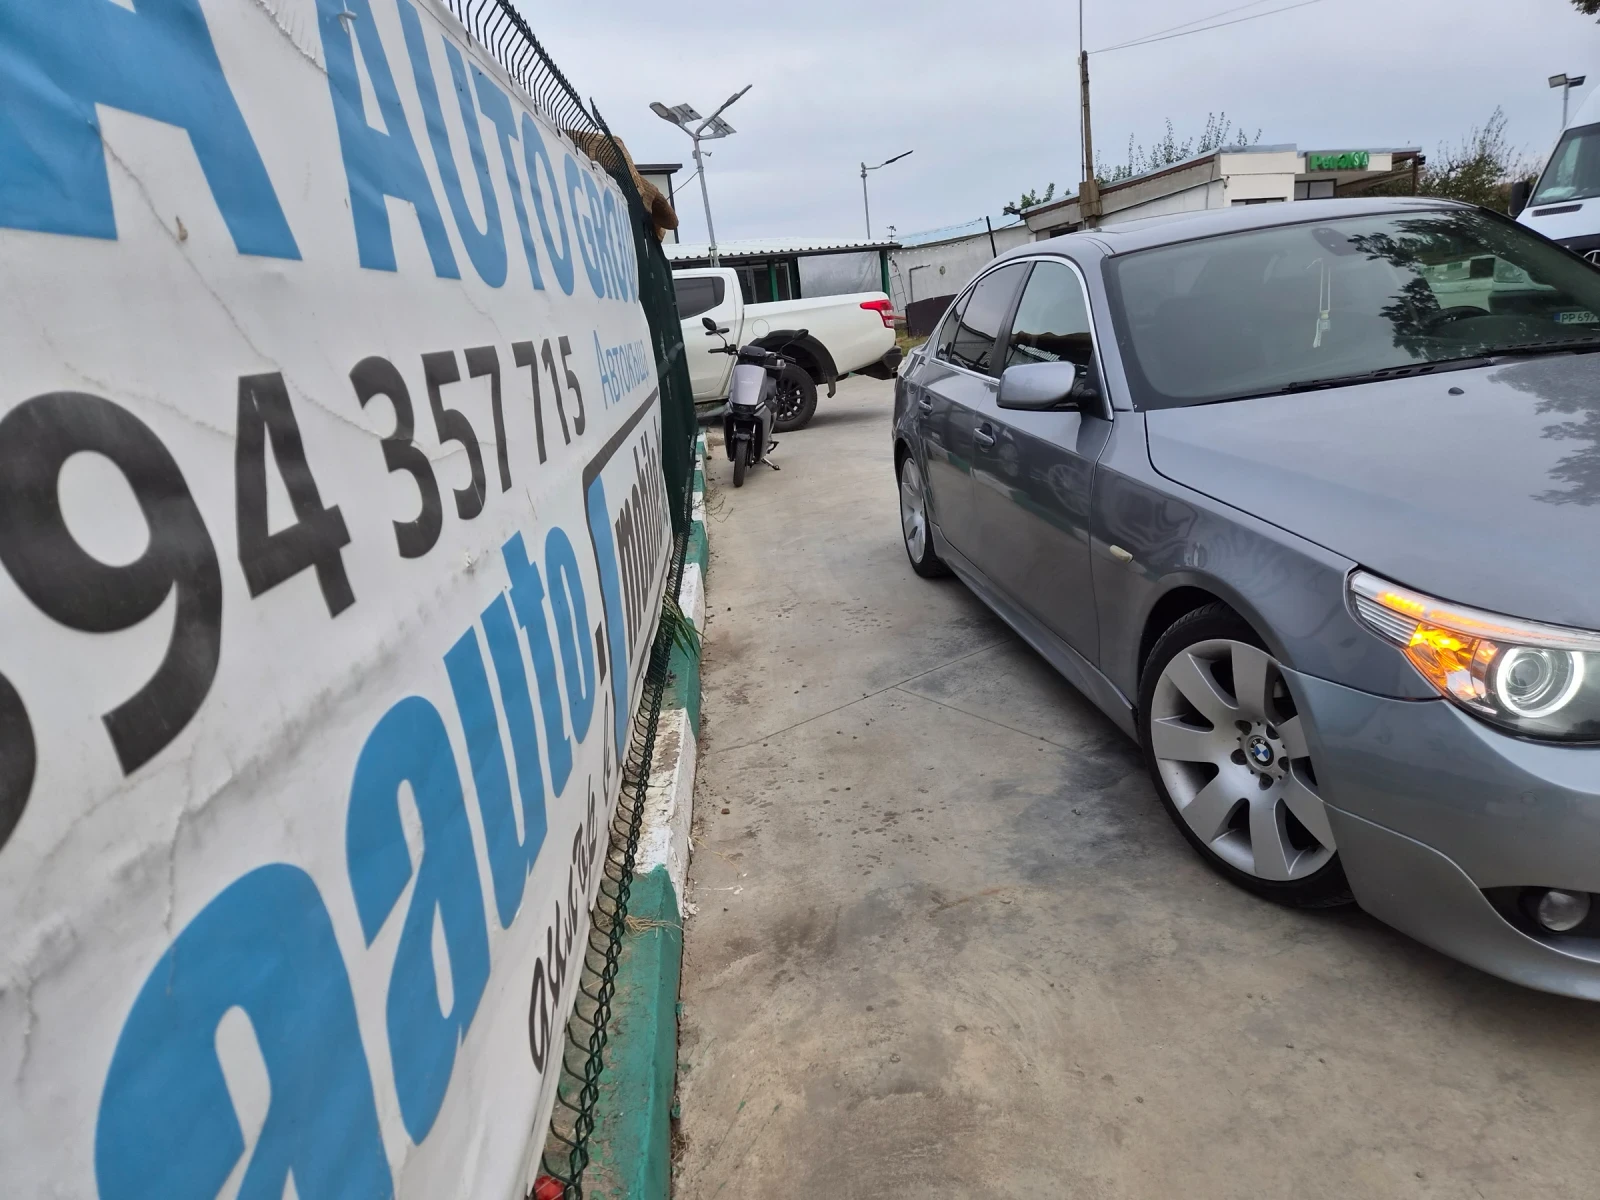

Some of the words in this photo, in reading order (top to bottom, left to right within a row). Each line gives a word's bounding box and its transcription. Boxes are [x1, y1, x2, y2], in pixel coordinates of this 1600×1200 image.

[317, 0, 575, 296] AUTO
[348, 345, 513, 559] 357
[511, 335, 586, 466] 715
